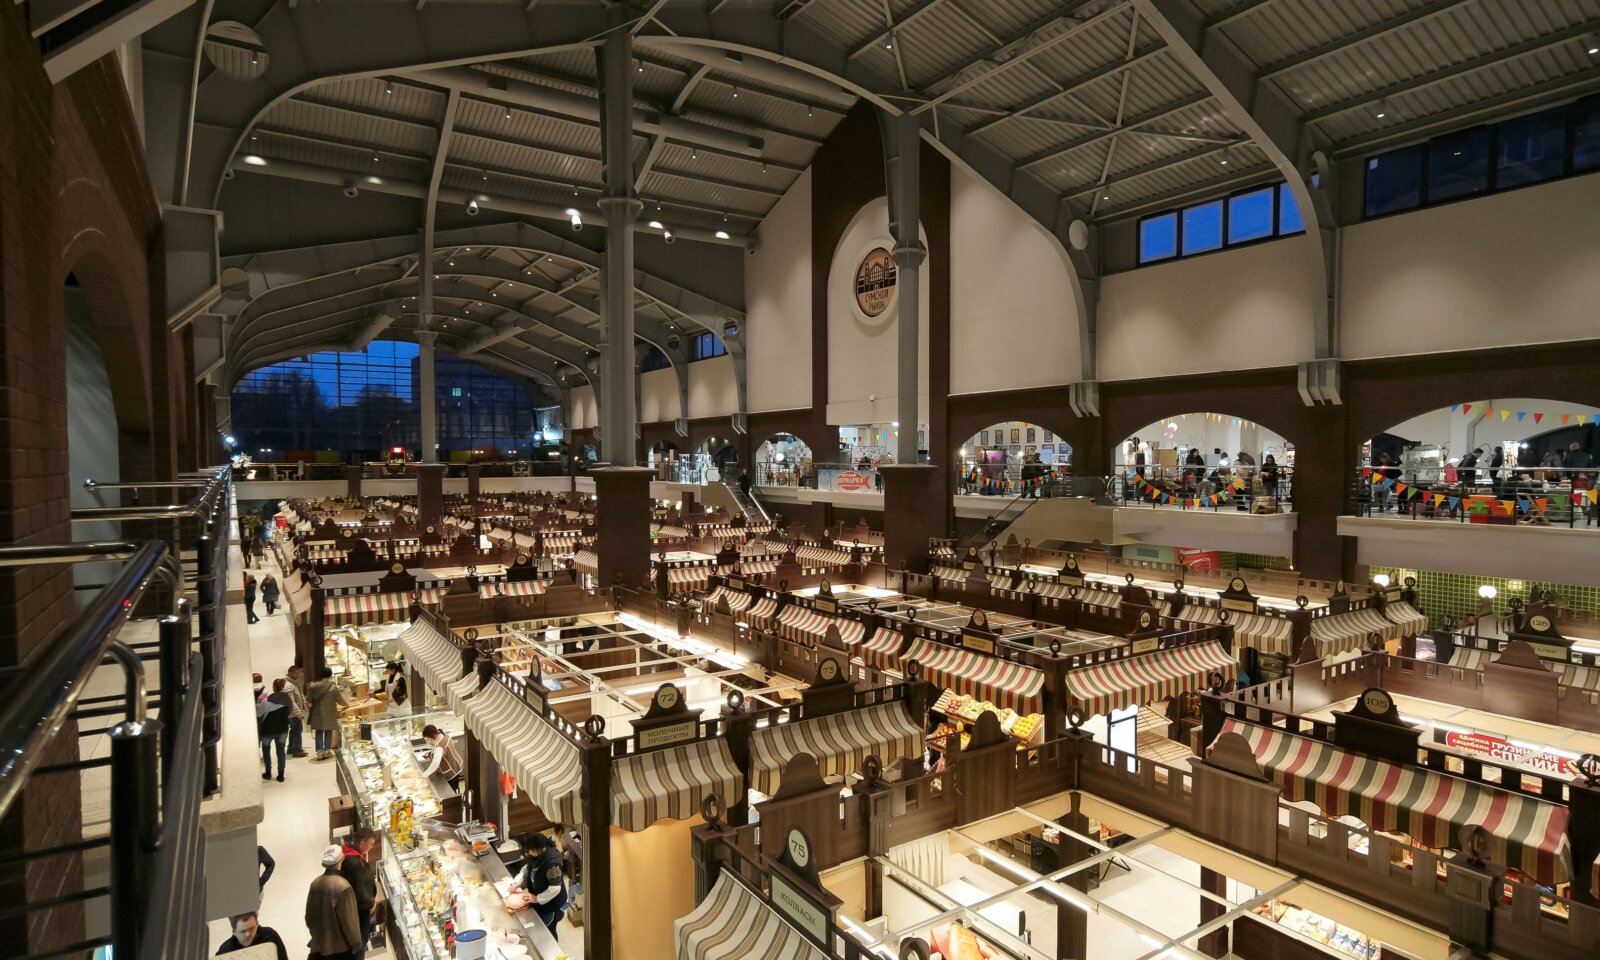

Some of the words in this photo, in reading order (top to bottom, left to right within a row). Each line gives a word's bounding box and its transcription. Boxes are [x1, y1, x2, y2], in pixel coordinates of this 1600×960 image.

[1532, 619, 1549, 627] 126
[660, 692, 675, 703] 72
[1366, 697, 1388, 709] 105
[647, 724, 690, 738] МОЛОЧНЫЕ
[648, 731, 689, 745] ПРОДУКТЫ
[1491, 741, 1560, 763] ГРУЗИНКИЕ
[790, 839, 806, 858] 75
